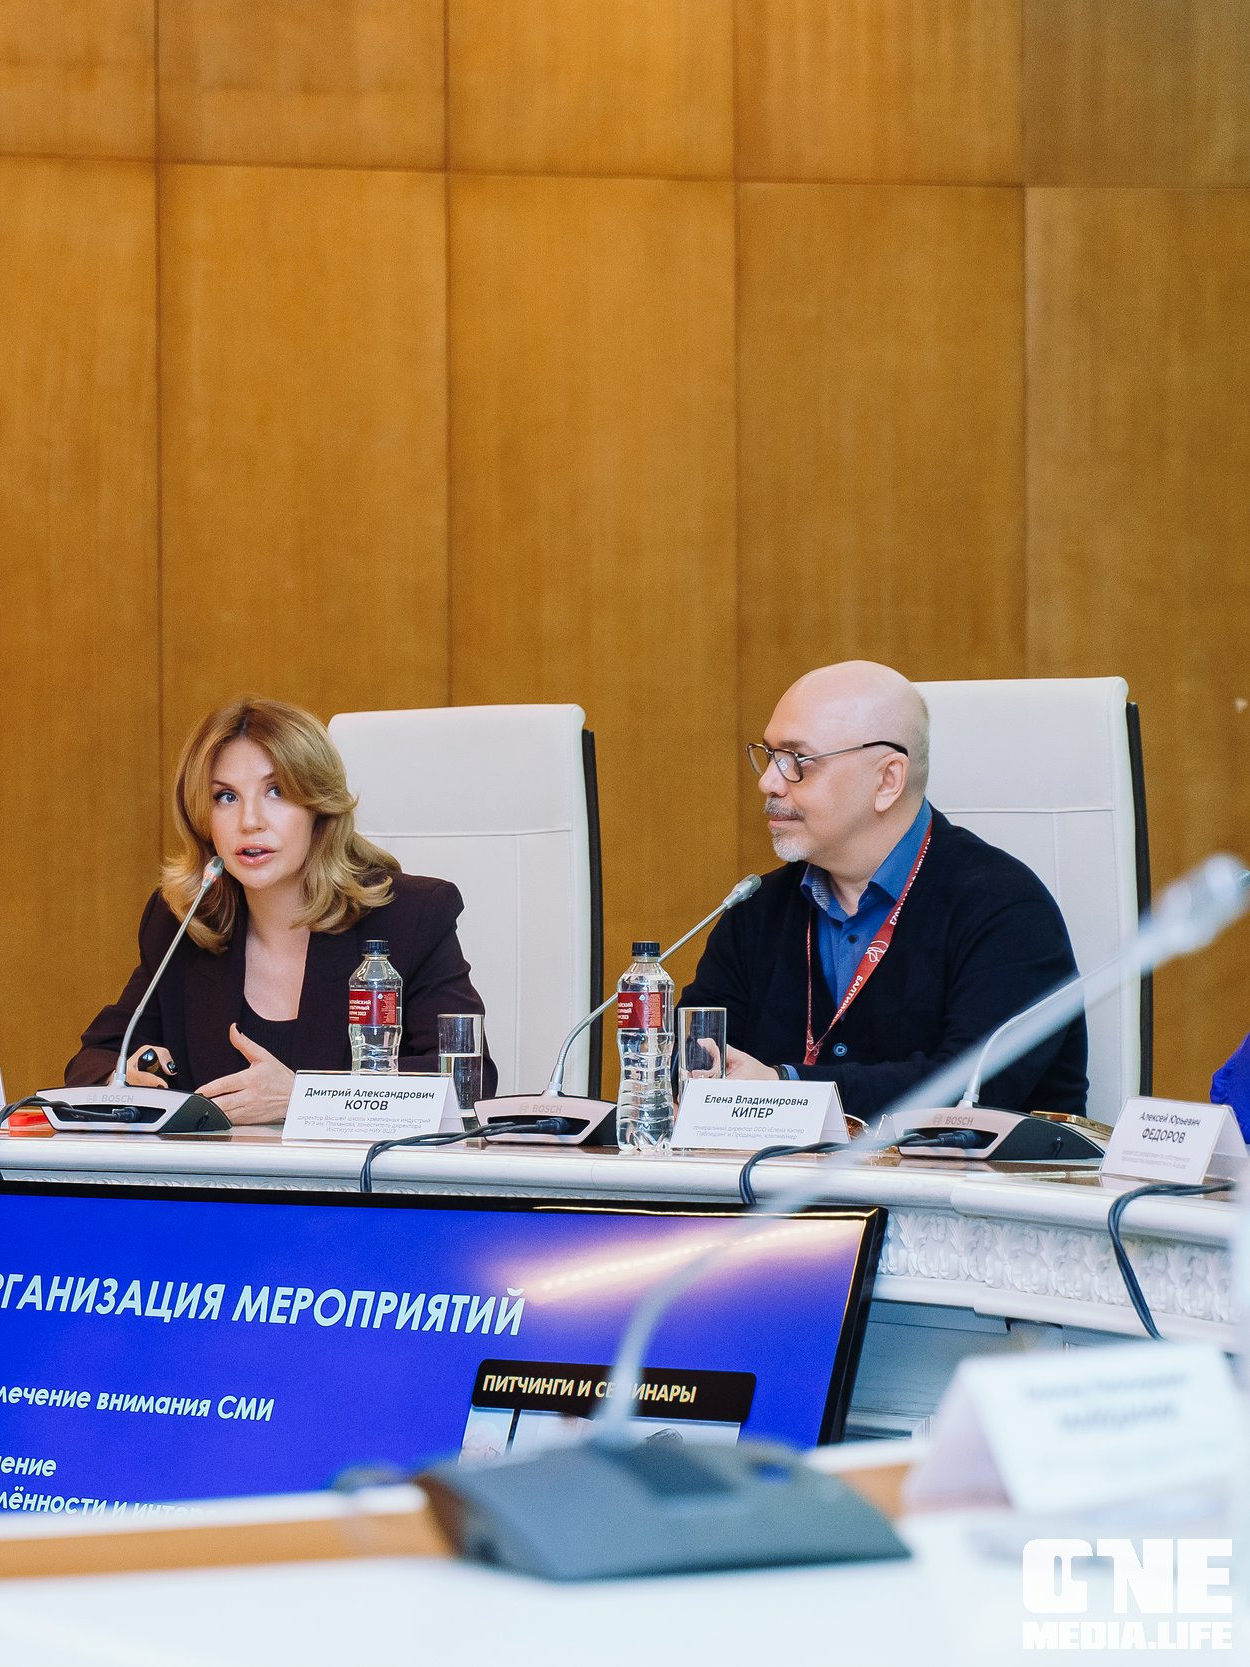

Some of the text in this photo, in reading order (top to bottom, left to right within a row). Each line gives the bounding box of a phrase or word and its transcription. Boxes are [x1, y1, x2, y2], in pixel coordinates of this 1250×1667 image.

[101, 1094, 134, 1104] BOSCH
[305, 1088, 435, 1100] Дмитрий Александрович
[344, 1100, 389, 1111] КОТОВ
[704, 1095, 809, 1107] Елена Владимировна
[532, 1105, 563, 1113] BOSCH
[731, 1107, 774, 1119] КИПЕР
[944, 1115, 974, 1125] BOSCH
[1140, 1112, 1201, 1127] Алексей Юрьевич
[1142, 1128, 1186, 1144] ФЕДОРОВ
[231, 1285, 526, 1336] МЕРОПРИЯТИЙ
[482, 1374, 698, 1403] ПИТЧИНГИ И СЕИНАРЫ
[96, 1393, 211, 1417] внимания
[217, 1395, 274, 1422] СМИ
